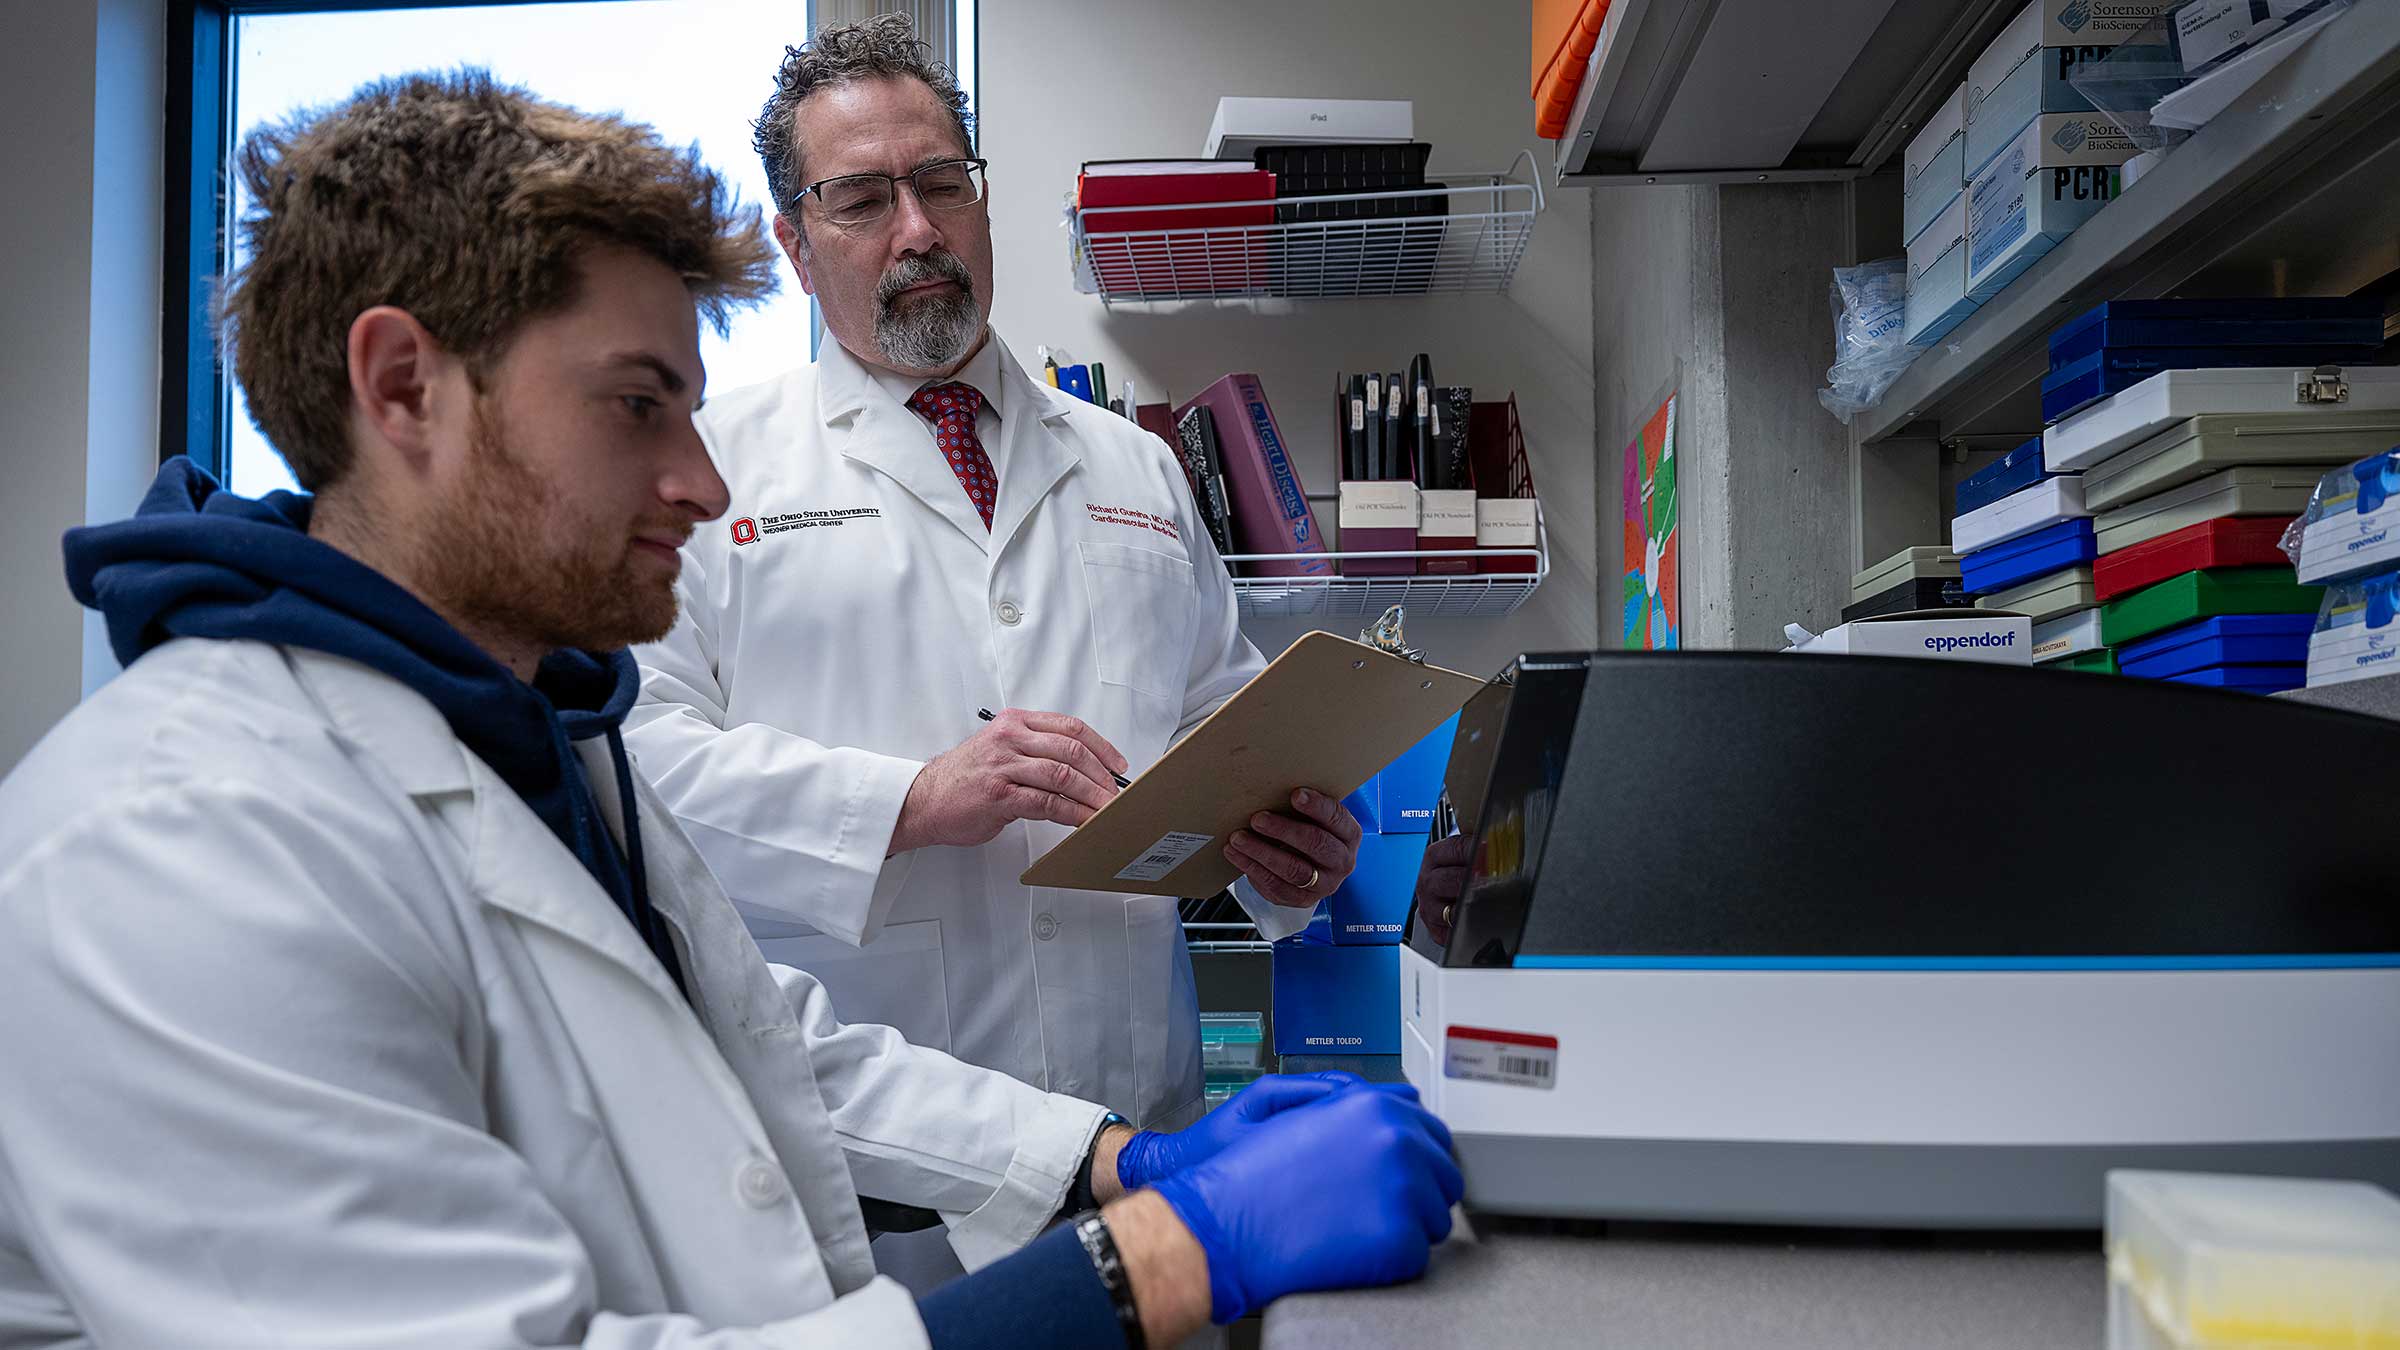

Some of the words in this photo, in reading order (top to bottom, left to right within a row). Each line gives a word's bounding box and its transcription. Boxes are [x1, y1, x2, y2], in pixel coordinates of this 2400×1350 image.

[2092, 1, 2160, 16] Sorenson
[1310, 111, 1327, 122] iPad
[2053, 166, 2109, 201] PCR
[1258, 419, 1282, 459] Heart
[1273, 461, 1303, 518] Disease
[760, 516, 780, 526] THE
[829, 507, 880, 517] UNIVERSITY
[1086, 503, 1119, 515] Richard
[762, 525, 791, 535] WEXNER
[790, 521, 818, 531] MEDICAL
[818, 519, 843, 528] CENTER
[1090, 513, 1149, 529] Cardiovascular
[2347, 529, 2388, 552] eppendorf
[1924, 631, 2015, 653] eppendorf
[2356, 646, 2396, 667] eppendorf
[1401, 809, 1430, 818] METTLER
[1346, 924, 1374, 933] METTLER
[1376, 924, 1402, 932] TOLEDO
[1305, 1037, 1334, 1045] METTLER
[1336, 1037, 1362, 1045] TOLEDO
